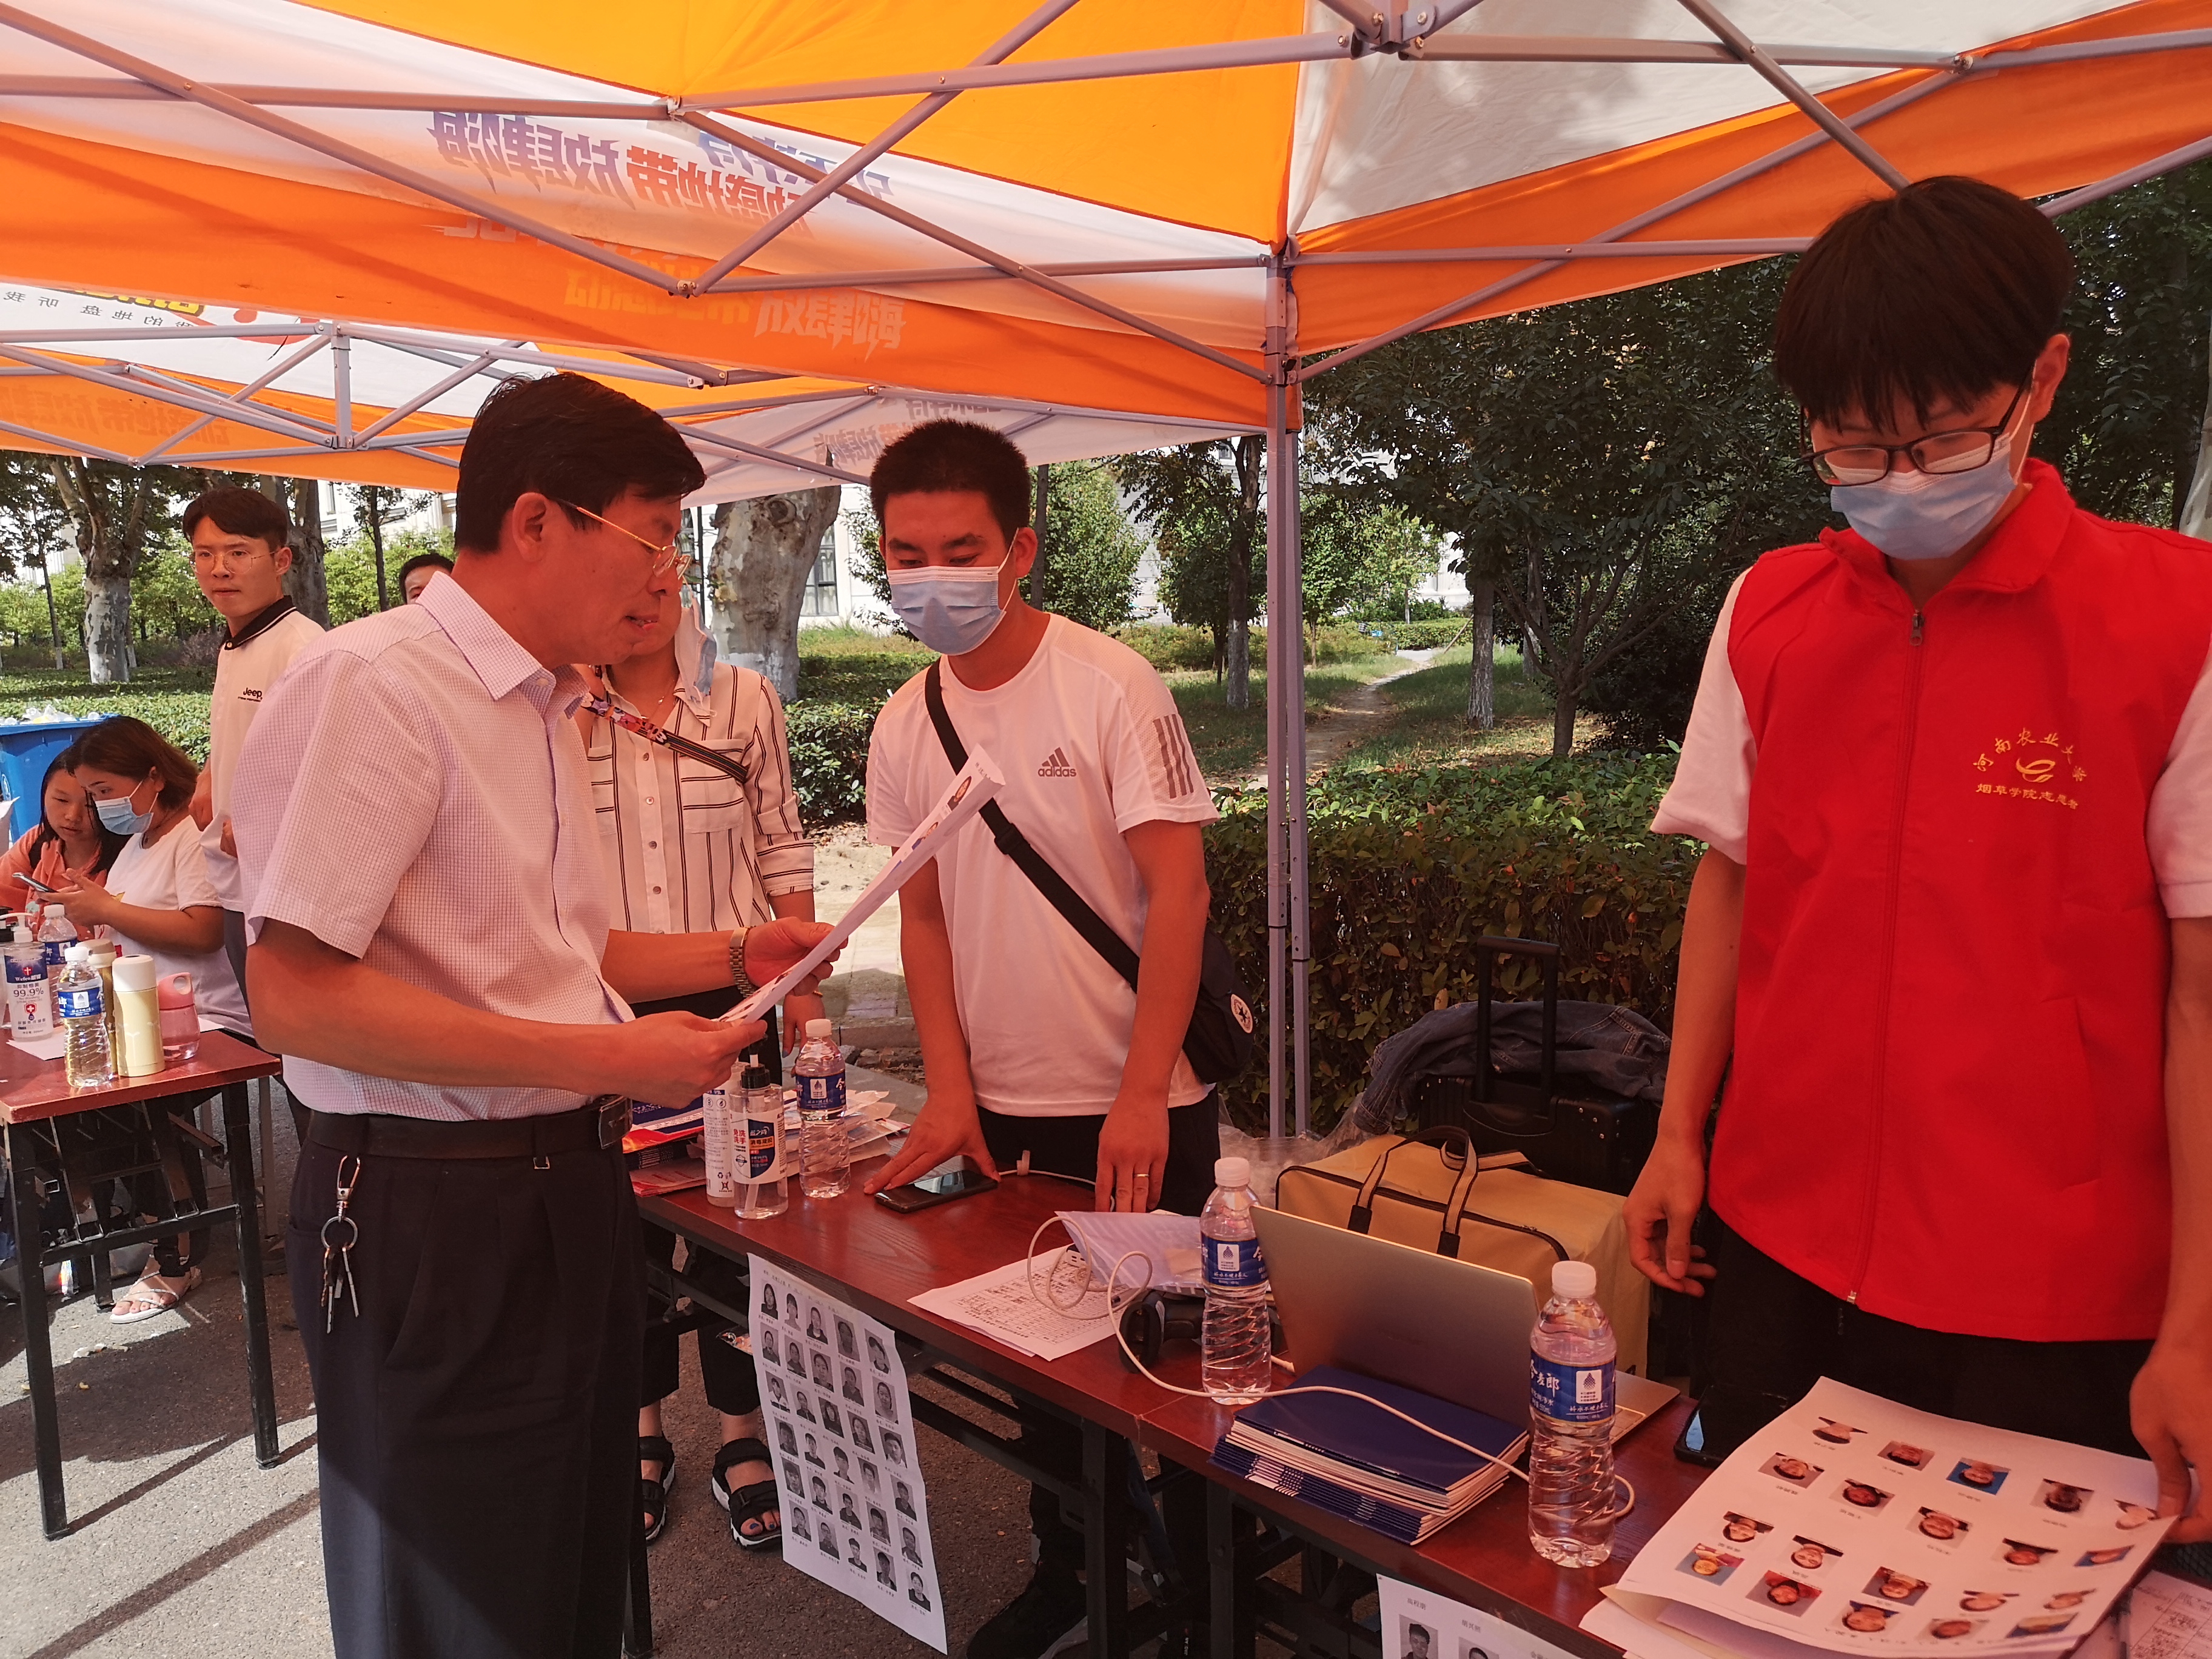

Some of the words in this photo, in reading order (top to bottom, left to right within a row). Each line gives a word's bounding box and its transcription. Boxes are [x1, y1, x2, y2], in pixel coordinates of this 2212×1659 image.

[243, 687, 262, 699] Jeep
[1037, 766, 1077, 777] adidas
[1976, 783, 2079, 810] 烟草学院志愿者
[13, 987, 44, 997] 99.9%
